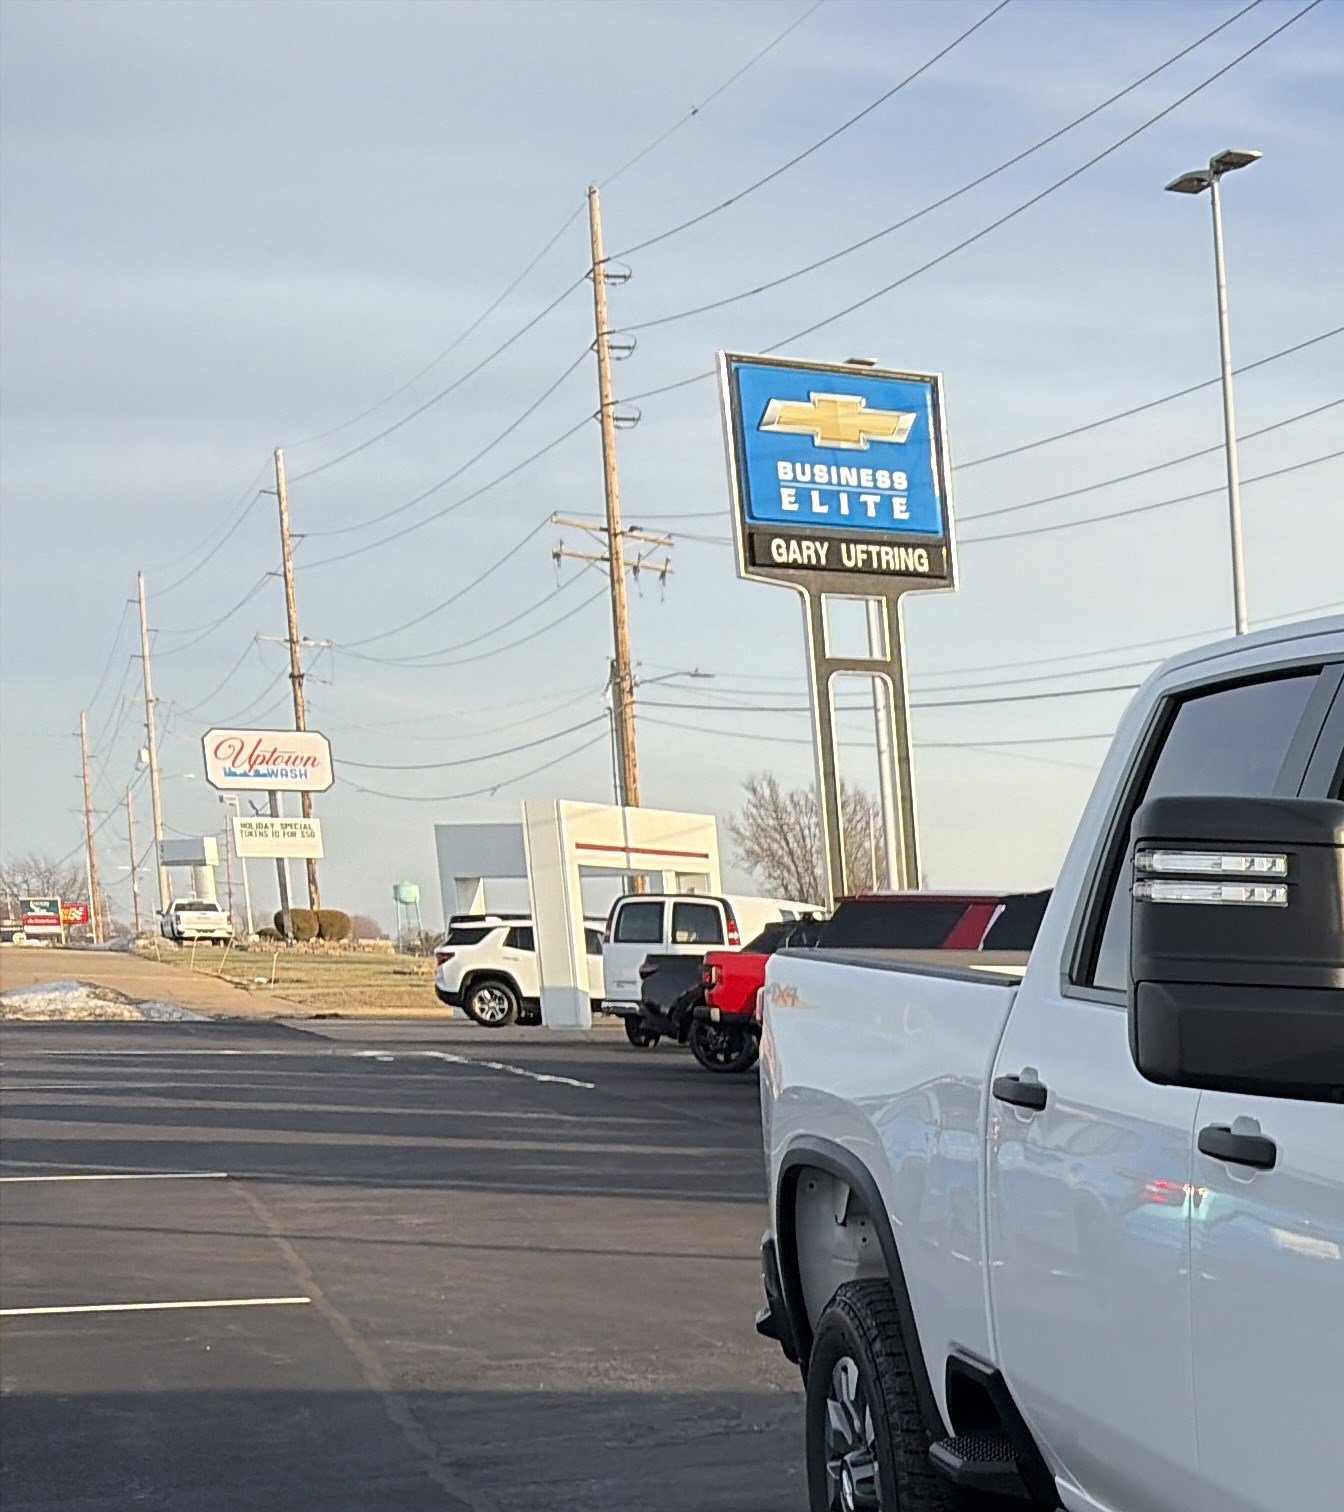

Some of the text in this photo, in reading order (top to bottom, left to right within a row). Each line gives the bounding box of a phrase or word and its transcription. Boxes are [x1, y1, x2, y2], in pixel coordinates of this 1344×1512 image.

[777, 461, 908, 490] BUSINESS
[780, 488, 910, 520] ELITE
[771, 537, 929, 572] GARY UFTRING
[213, 737, 319, 772] Uptown
[267, 768, 308, 779] WASH
[240, 822, 275, 830] HOLIDAY
